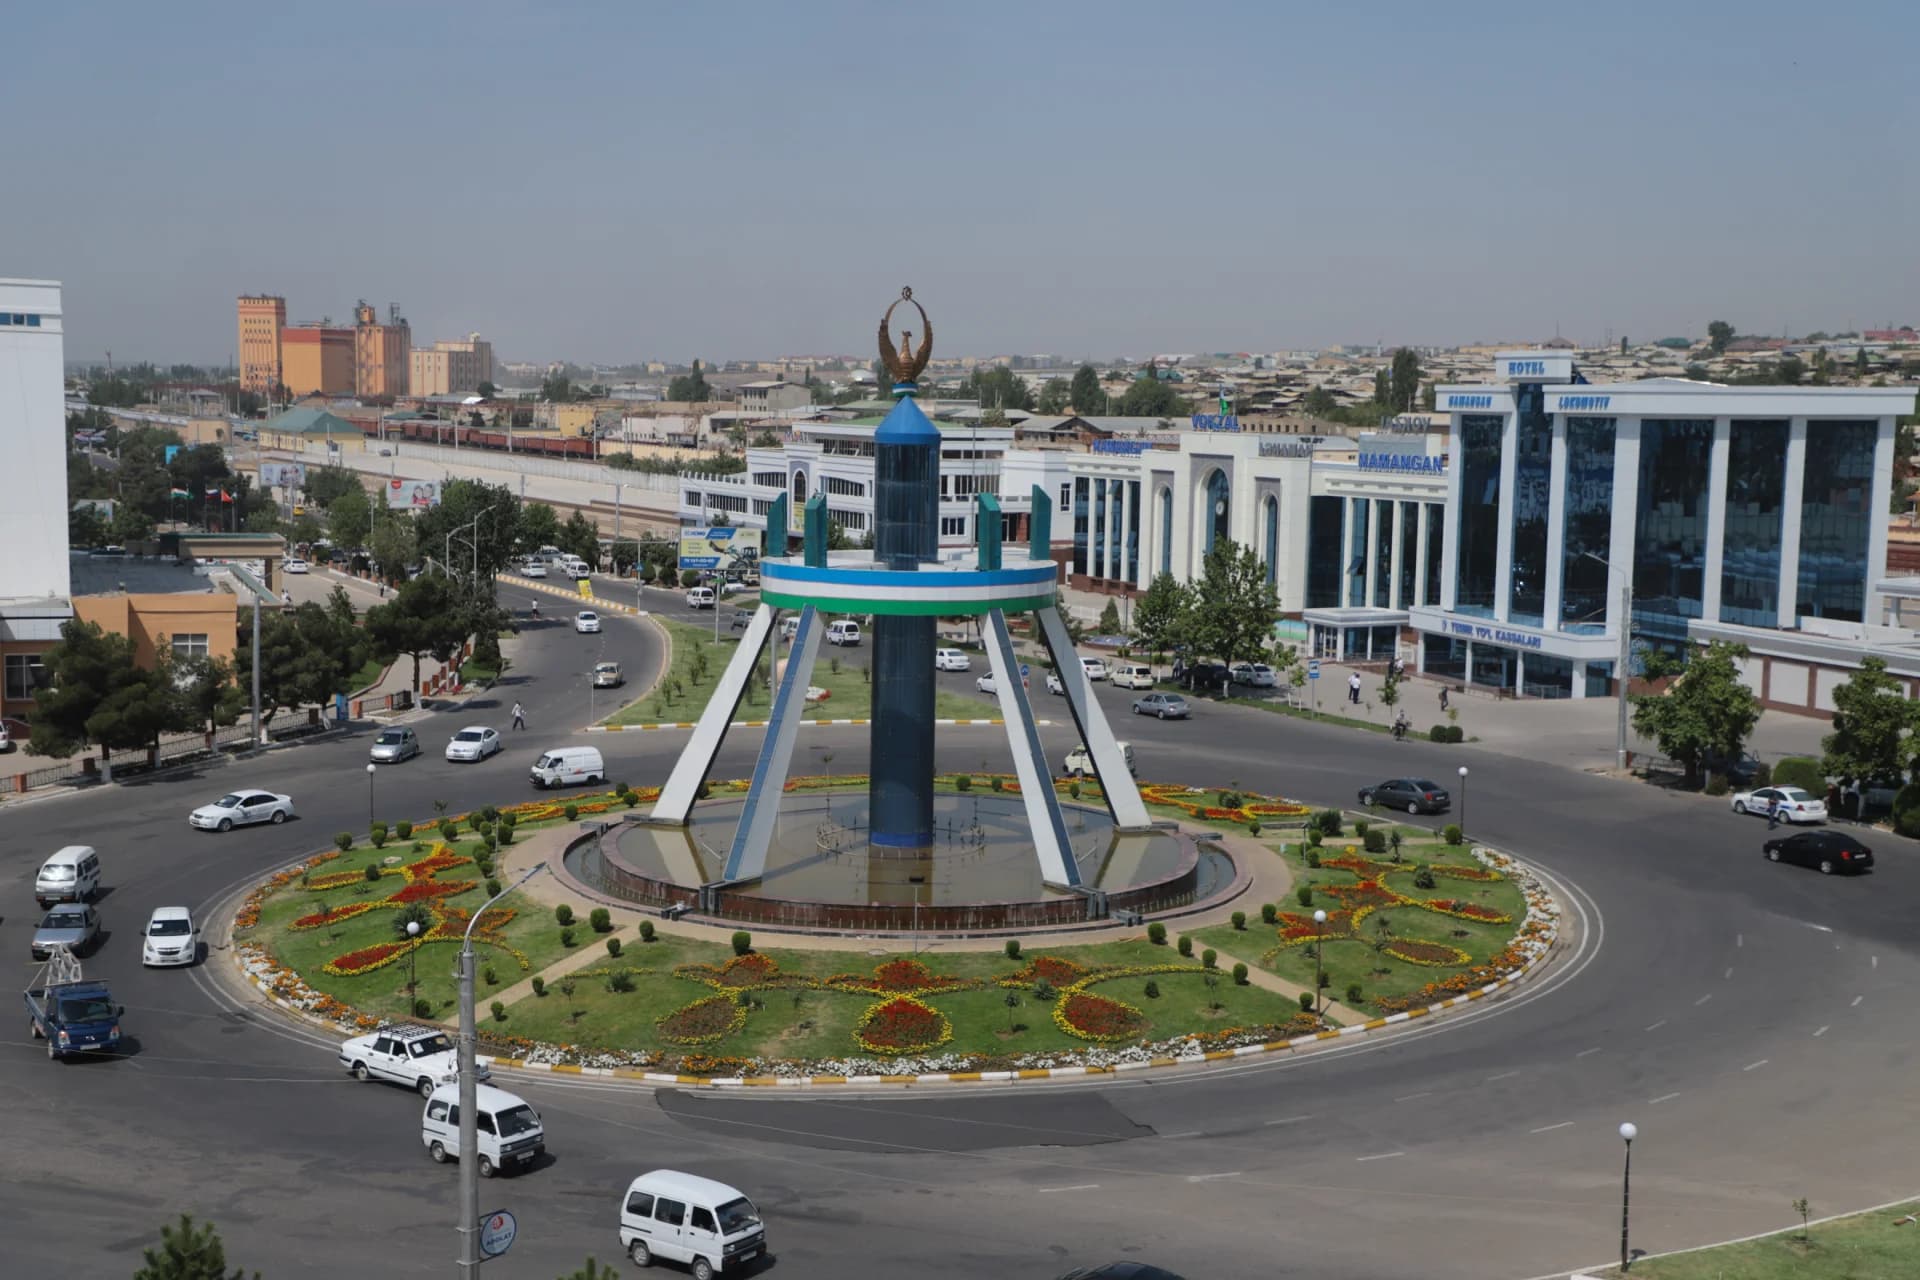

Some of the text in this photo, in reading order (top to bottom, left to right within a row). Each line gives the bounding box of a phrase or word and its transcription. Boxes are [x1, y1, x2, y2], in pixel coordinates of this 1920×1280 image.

[1508, 361, 1545, 376] HOTEL
[1191, 414, 1240, 430] VOKZAL
[1359, 452, 1443, 472] NAMANGAN
